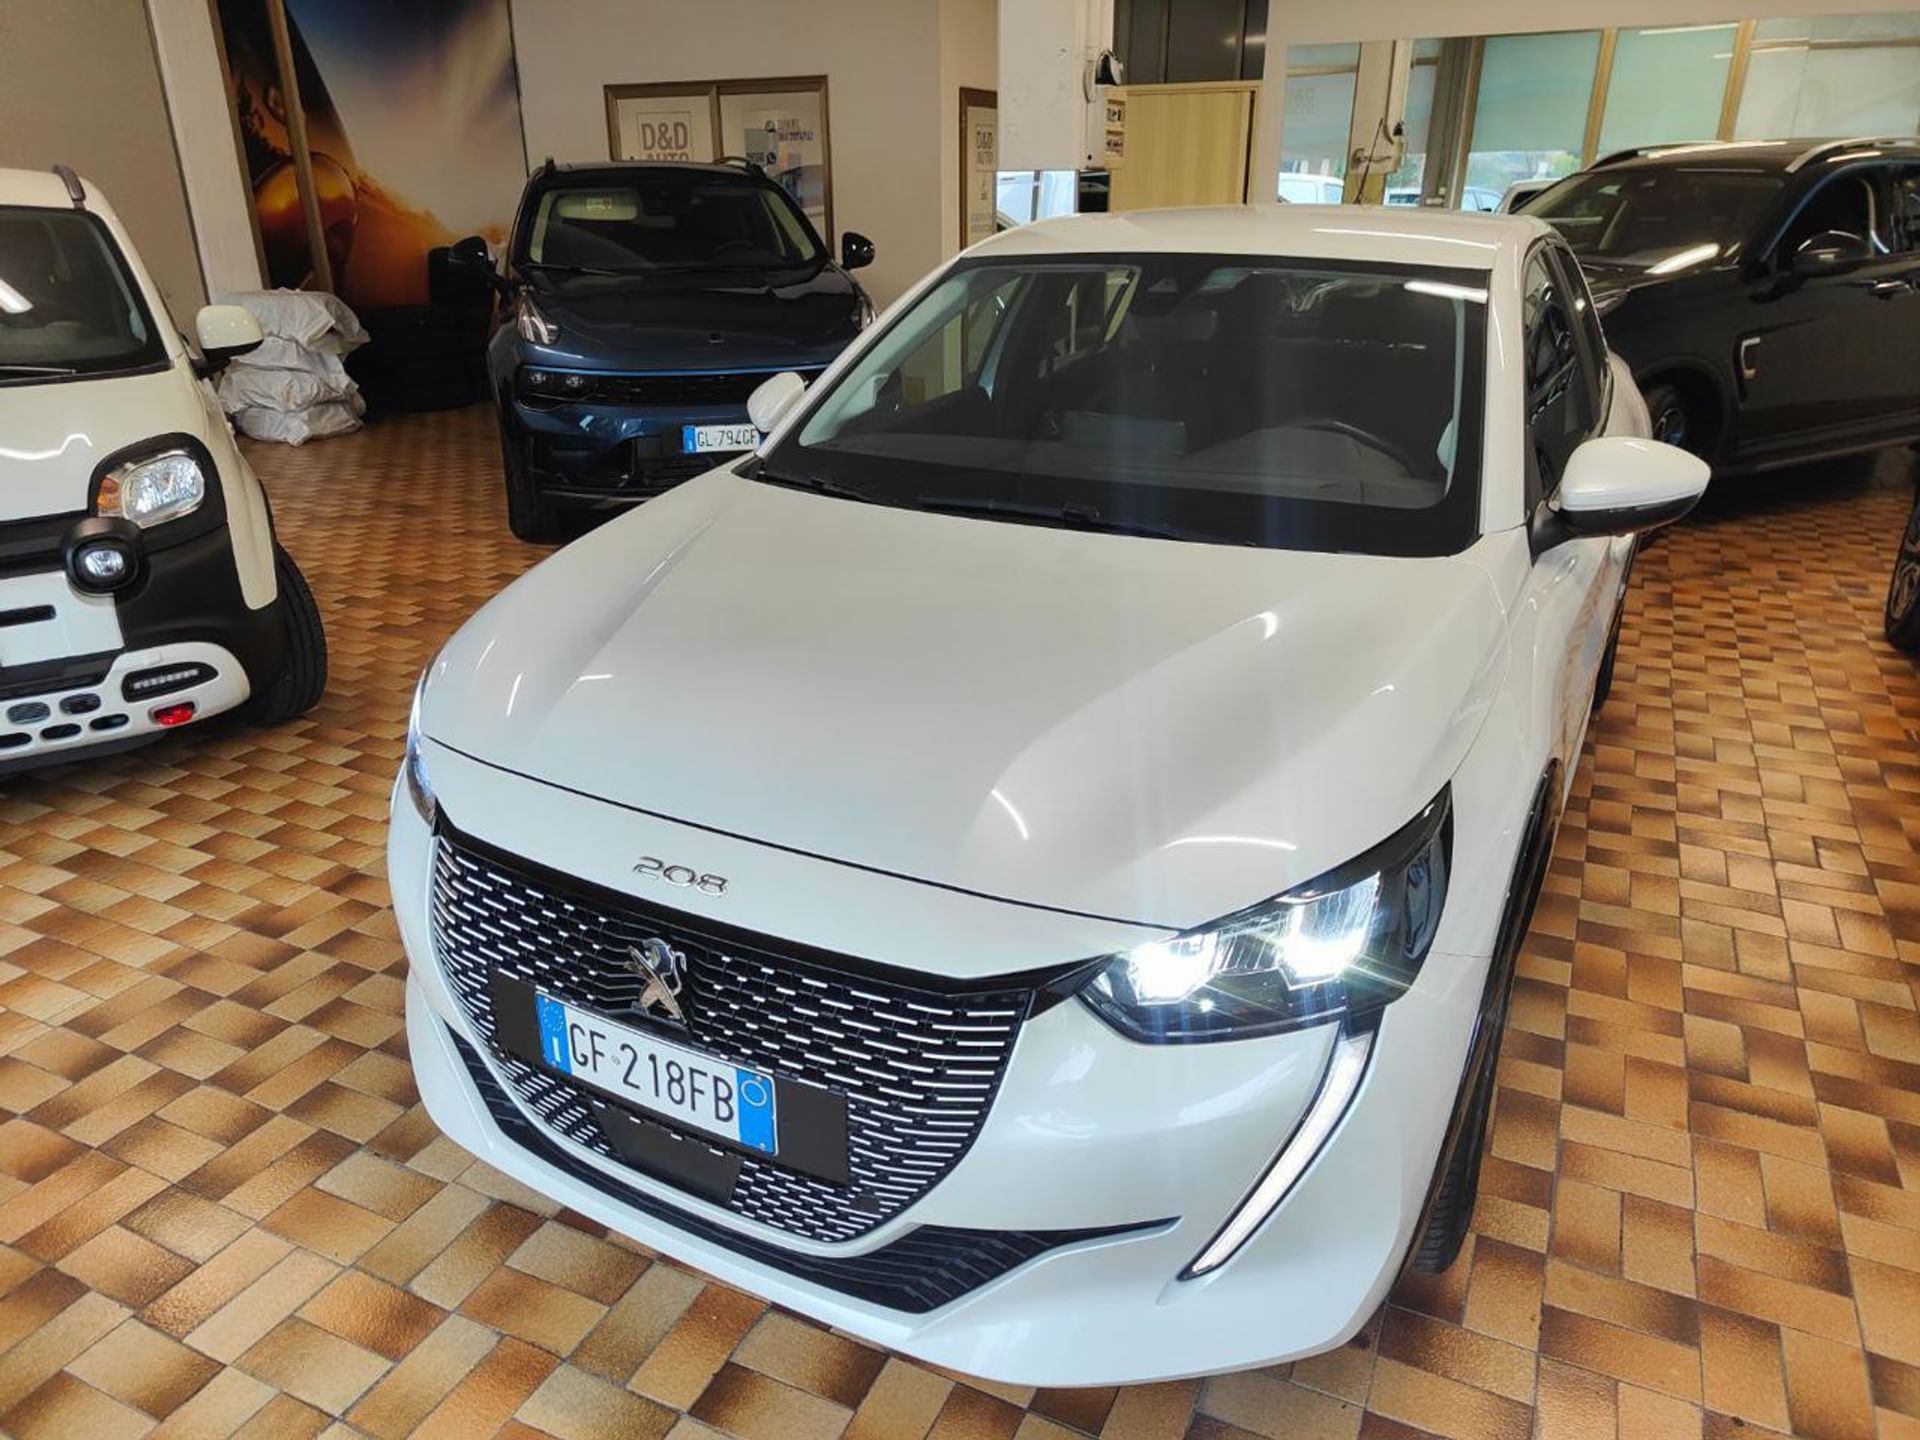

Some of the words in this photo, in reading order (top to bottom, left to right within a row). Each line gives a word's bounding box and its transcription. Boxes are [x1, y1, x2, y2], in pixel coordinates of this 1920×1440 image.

[641, 121, 688, 150] D&D
[632, 856, 729, 896] 208
[569, 1023, 606, 1073] GF
[619, 1043, 735, 1123] 218FB
